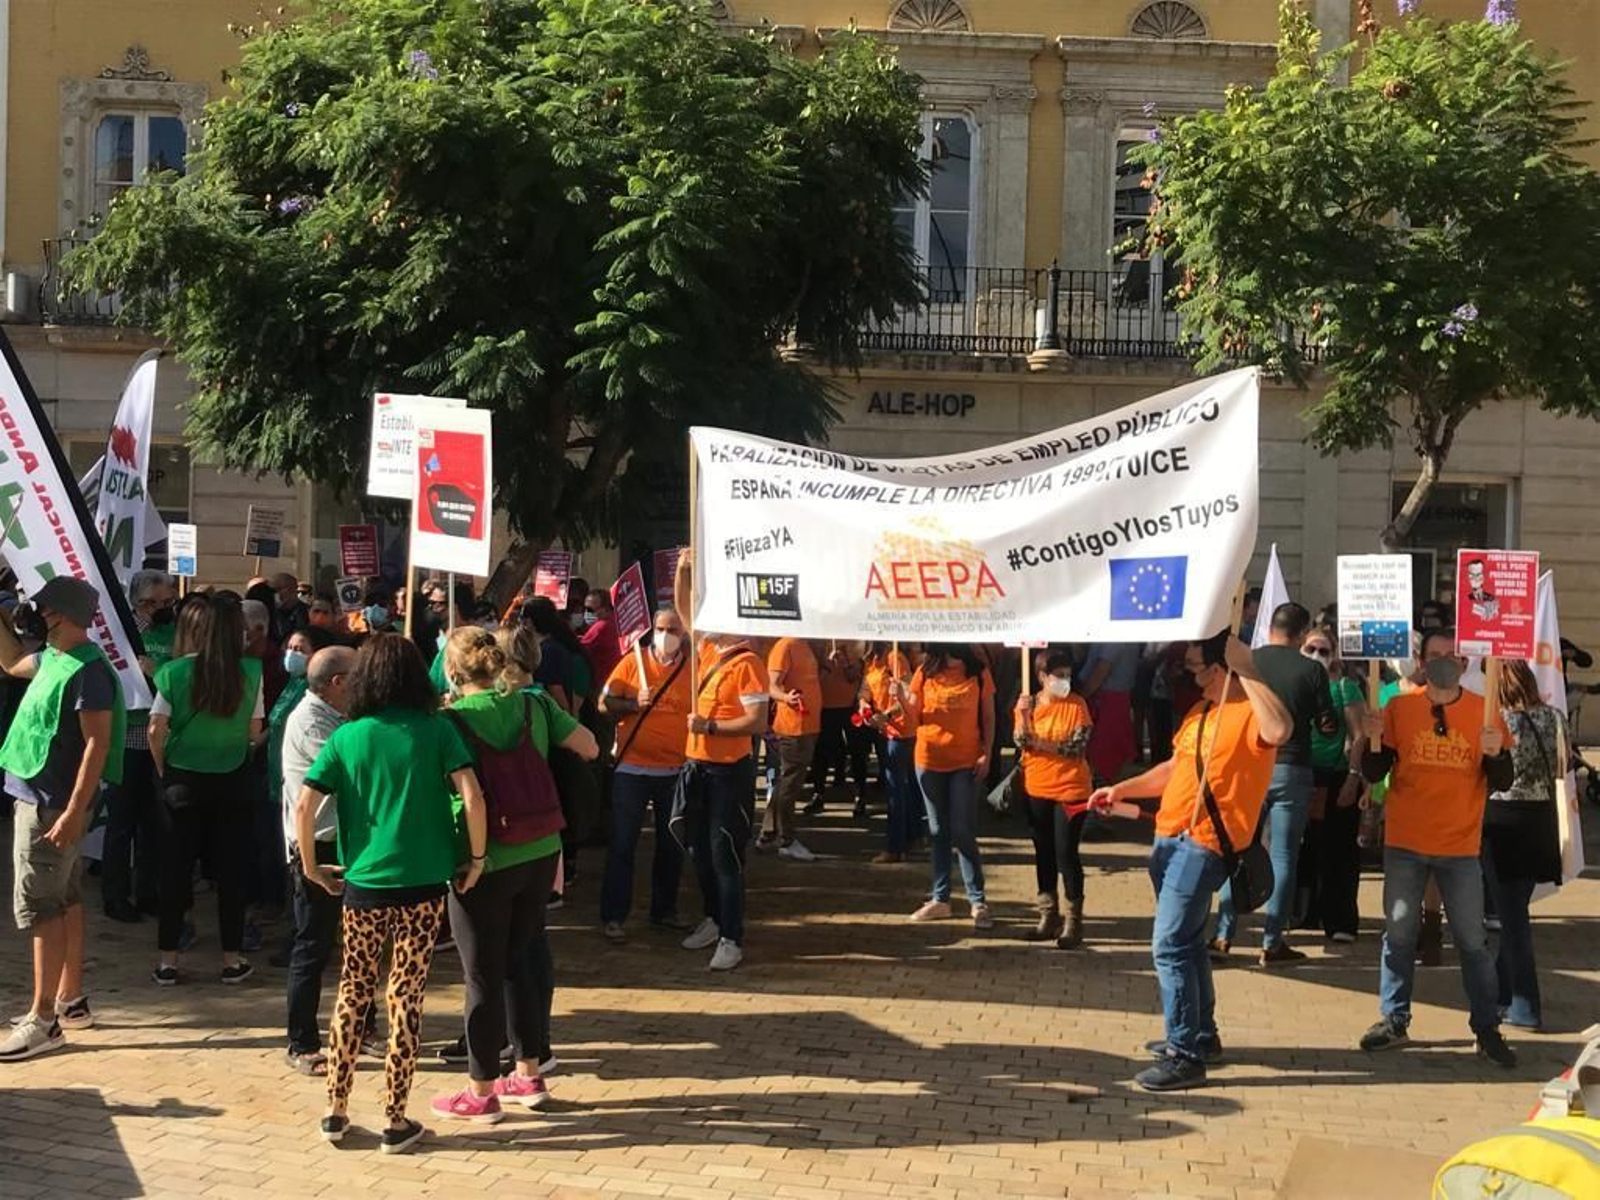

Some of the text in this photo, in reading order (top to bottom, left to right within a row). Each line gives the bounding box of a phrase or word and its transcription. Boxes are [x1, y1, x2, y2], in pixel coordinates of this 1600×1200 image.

[867, 390, 976, 417] ALE-HOP
[798, 480, 907, 505] INCUMPLE
[909, 486, 936, 506] LA
[944, 474, 1052, 504] DIRECTIVA
[1006, 493, 1240, 571] #ContigoYlosTuyos
[865, 560, 1006, 599] AEEPA
